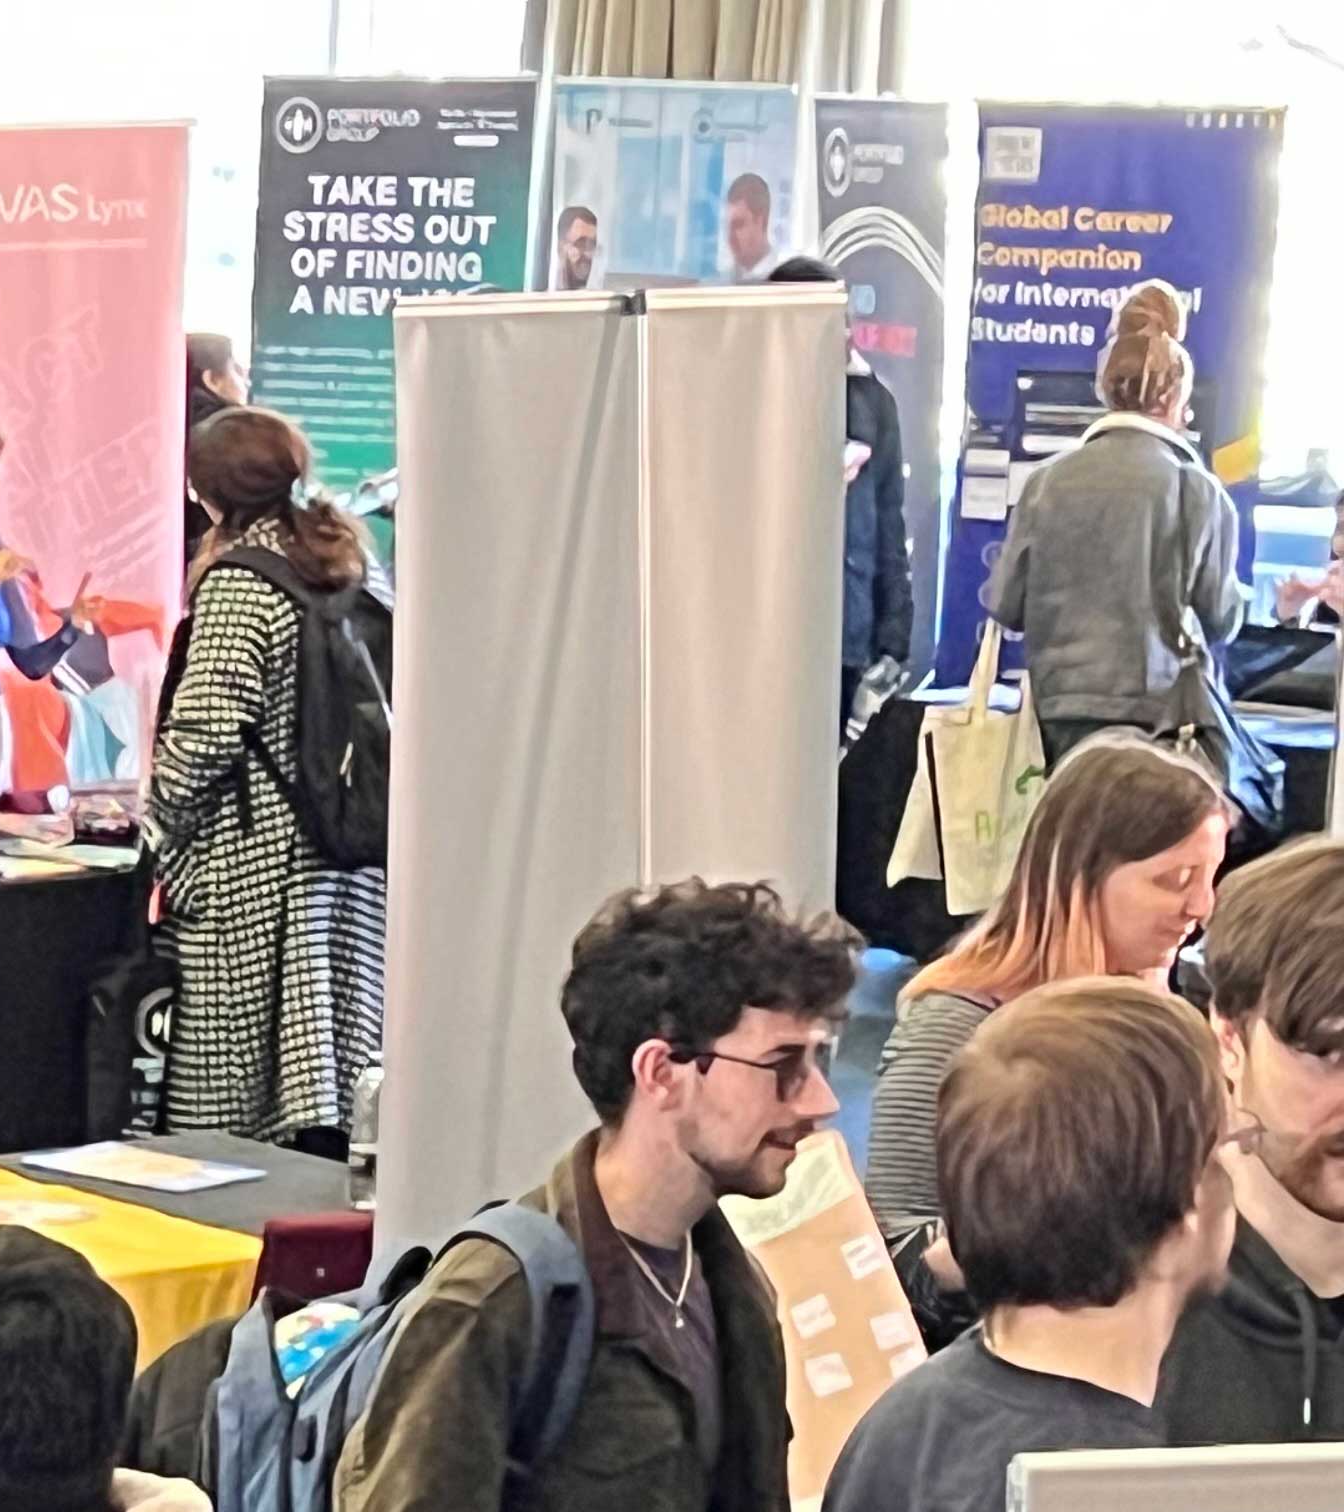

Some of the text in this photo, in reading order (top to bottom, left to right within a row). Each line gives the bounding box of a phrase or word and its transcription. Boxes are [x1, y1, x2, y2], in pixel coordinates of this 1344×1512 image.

[308, 174, 475, 208] TAKE THE
[282, 210, 497, 246] STRESS OUT
[980, 203, 1174, 234] Global Career
[290, 247, 483, 283] OF FINDING
[976, 242, 1143, 276] Companion
[289, 285, 314, 315] A
[971, 316, 1096, 346] Students
